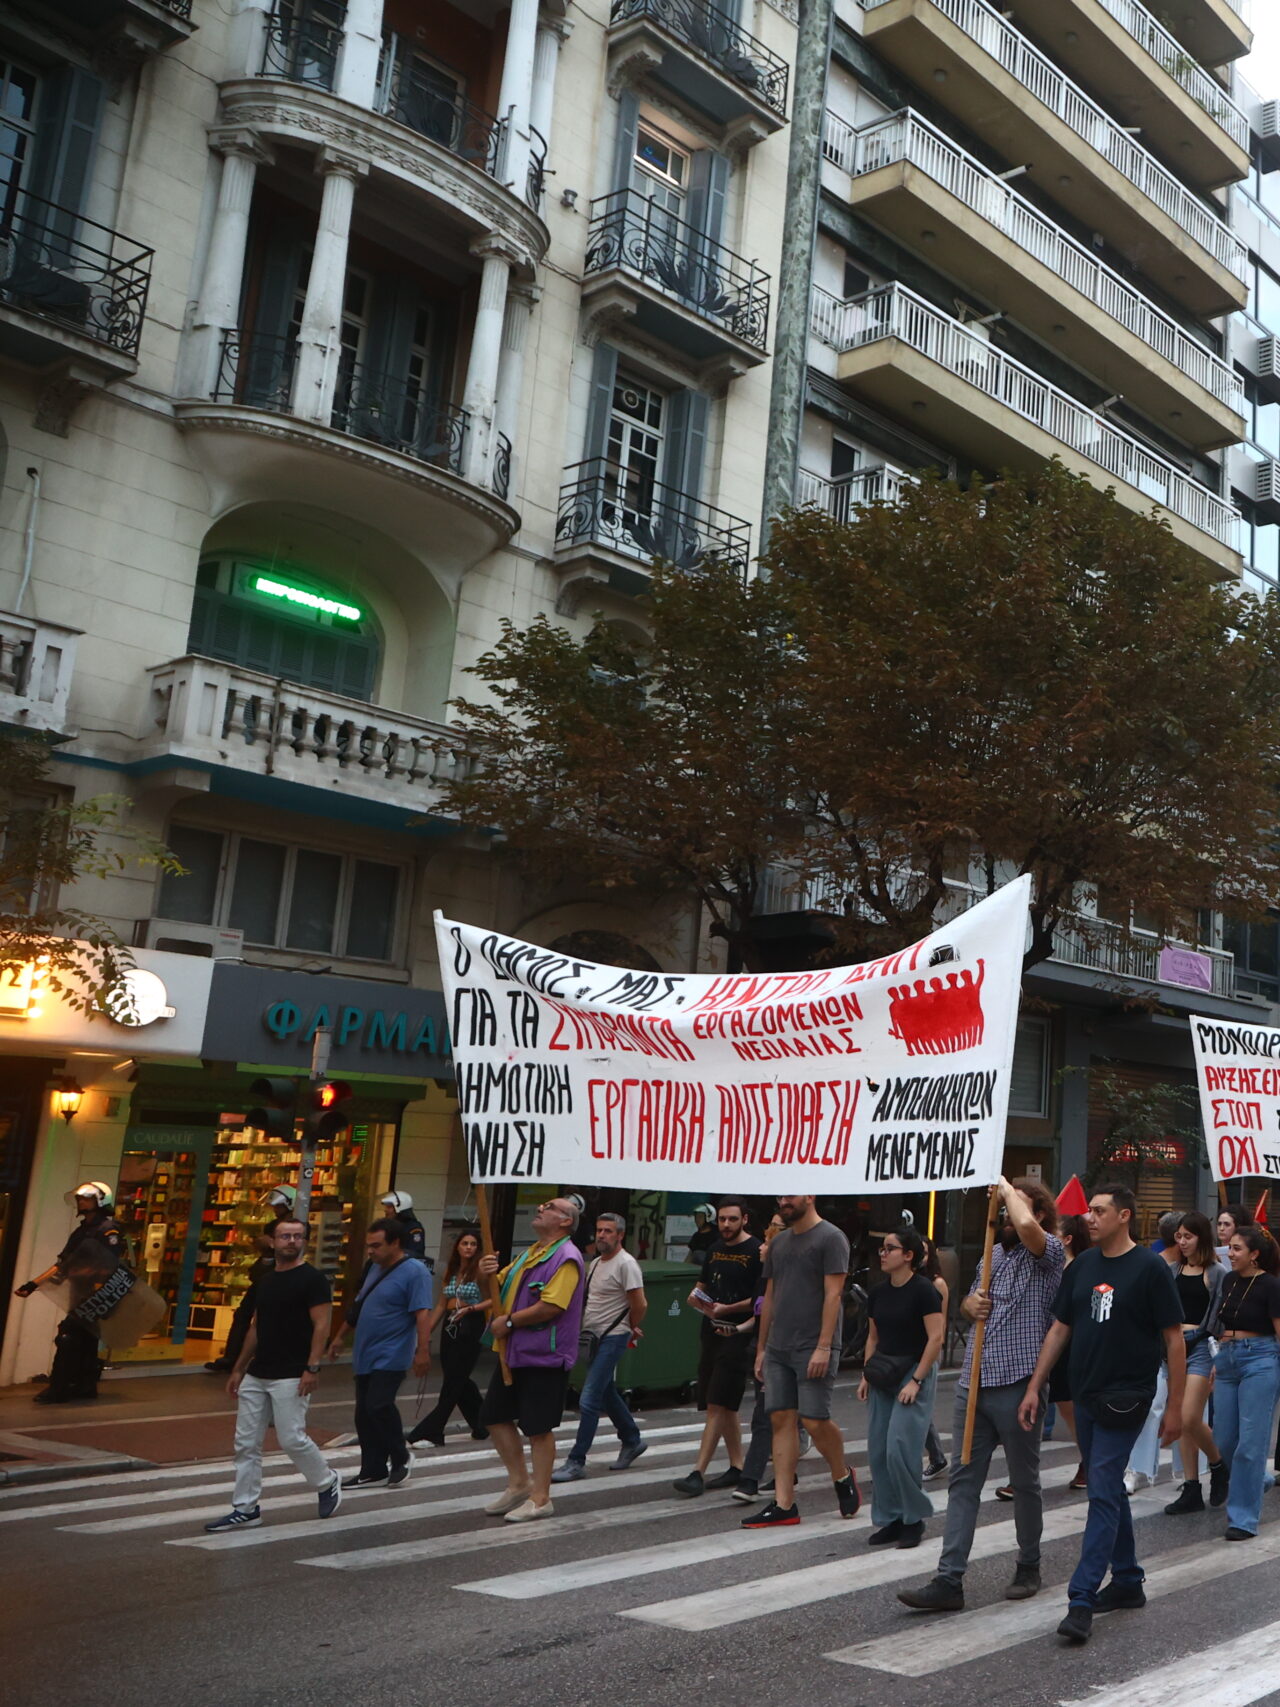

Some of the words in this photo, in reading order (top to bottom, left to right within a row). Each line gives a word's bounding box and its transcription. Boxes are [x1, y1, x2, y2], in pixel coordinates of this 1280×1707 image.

[450, 927, 471, 977] Ο
[453, 987, 497, 1047] ΓΙΑ
[507, 991, 540, 1048] ΤΑ
[693, 991, 864, 1039] ΕΡΓΑΖΟΜΕΝΩΝ
[731, 1028, 862, 1062] ΝΕΟΛΑΙΑΣ
[873, 1070, 997, 1123] ΑΜΠΕΛΟΚΗΠΩΝ
[1212, 1099, 1263, 1130] ΣΤΟΠ
[587, 1079, 705, 1164] ΕΡΓΑΤΙΚΗ
[715, 1078, 861, 1166] ΑΝΤΕΠΙΘΕΣΗ
[865, 1128, 979, 1181] ΜΕΝΕΜΕΝΗΣ
[1218, 1135, 1260, 1178] ΟΧΙ
[86, 1276, 134, 1322] POLICE
